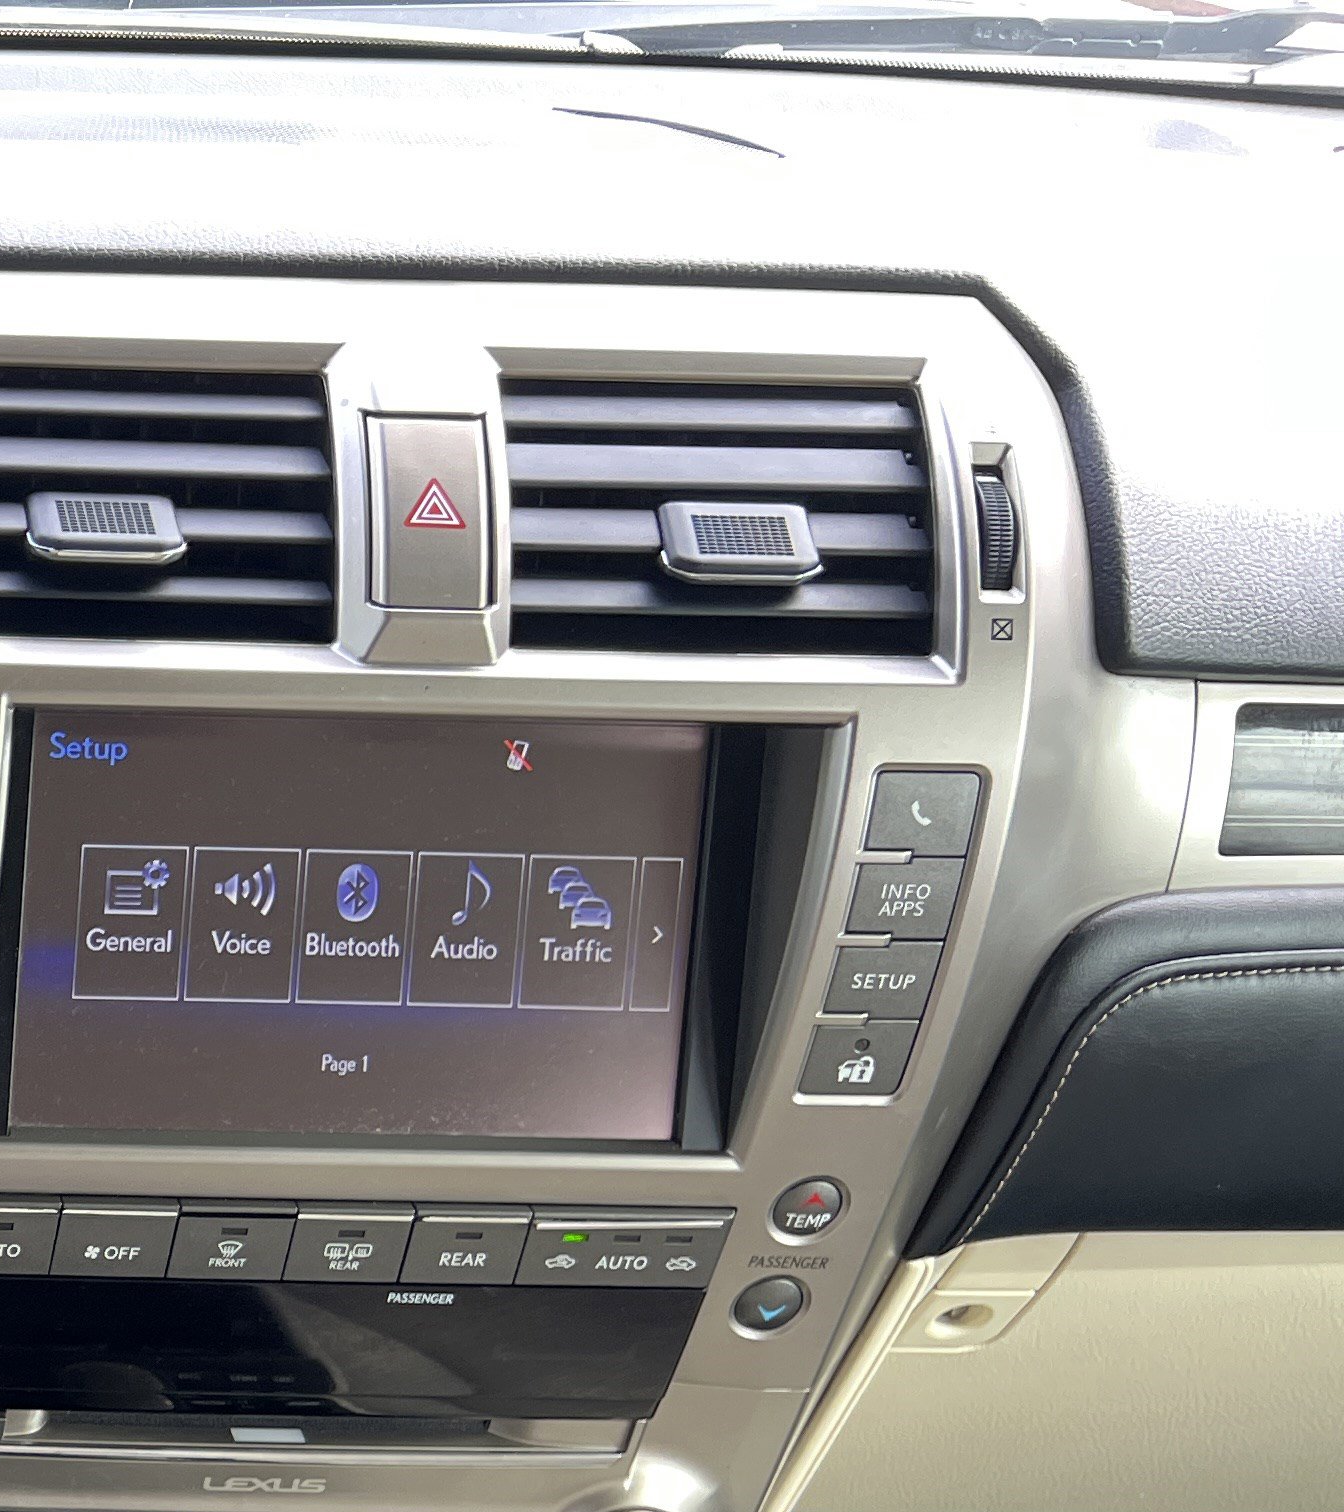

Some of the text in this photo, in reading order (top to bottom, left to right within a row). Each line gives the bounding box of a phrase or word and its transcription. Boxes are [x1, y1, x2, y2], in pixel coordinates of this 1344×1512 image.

[49, 731, 128, 765] Setup
[880, 882, 931, 901] INFO
[878, 900, 925, 918] APPS
[86, 927, 172, 955] General
[211, 930, 272, 956] Voice
[305, 932, 401, 960] Bluetooth
[430, 934, 499, 961] Audio
[539, 936, 613, 964] Traffic
[851, 972, 916, 991] SETUP
[321, 1051, 369, 1075] Page 1
[785, 1211, 831, 1230] TEMP
[104, 1244, 141, 1262] OFF
[208, 1256, 247, 1268] FRONT
[438, 1251, 487, 1268] REAR
[328, 1259, 360, 1272] REAR
[594, 1254, 648, 1272] AUTO
[747, 1254, 830, 1272] PASSENGER
[386, 1291, 454, 1305] PASSENGER
[202, 1476, 327, 1494] LEXUS
